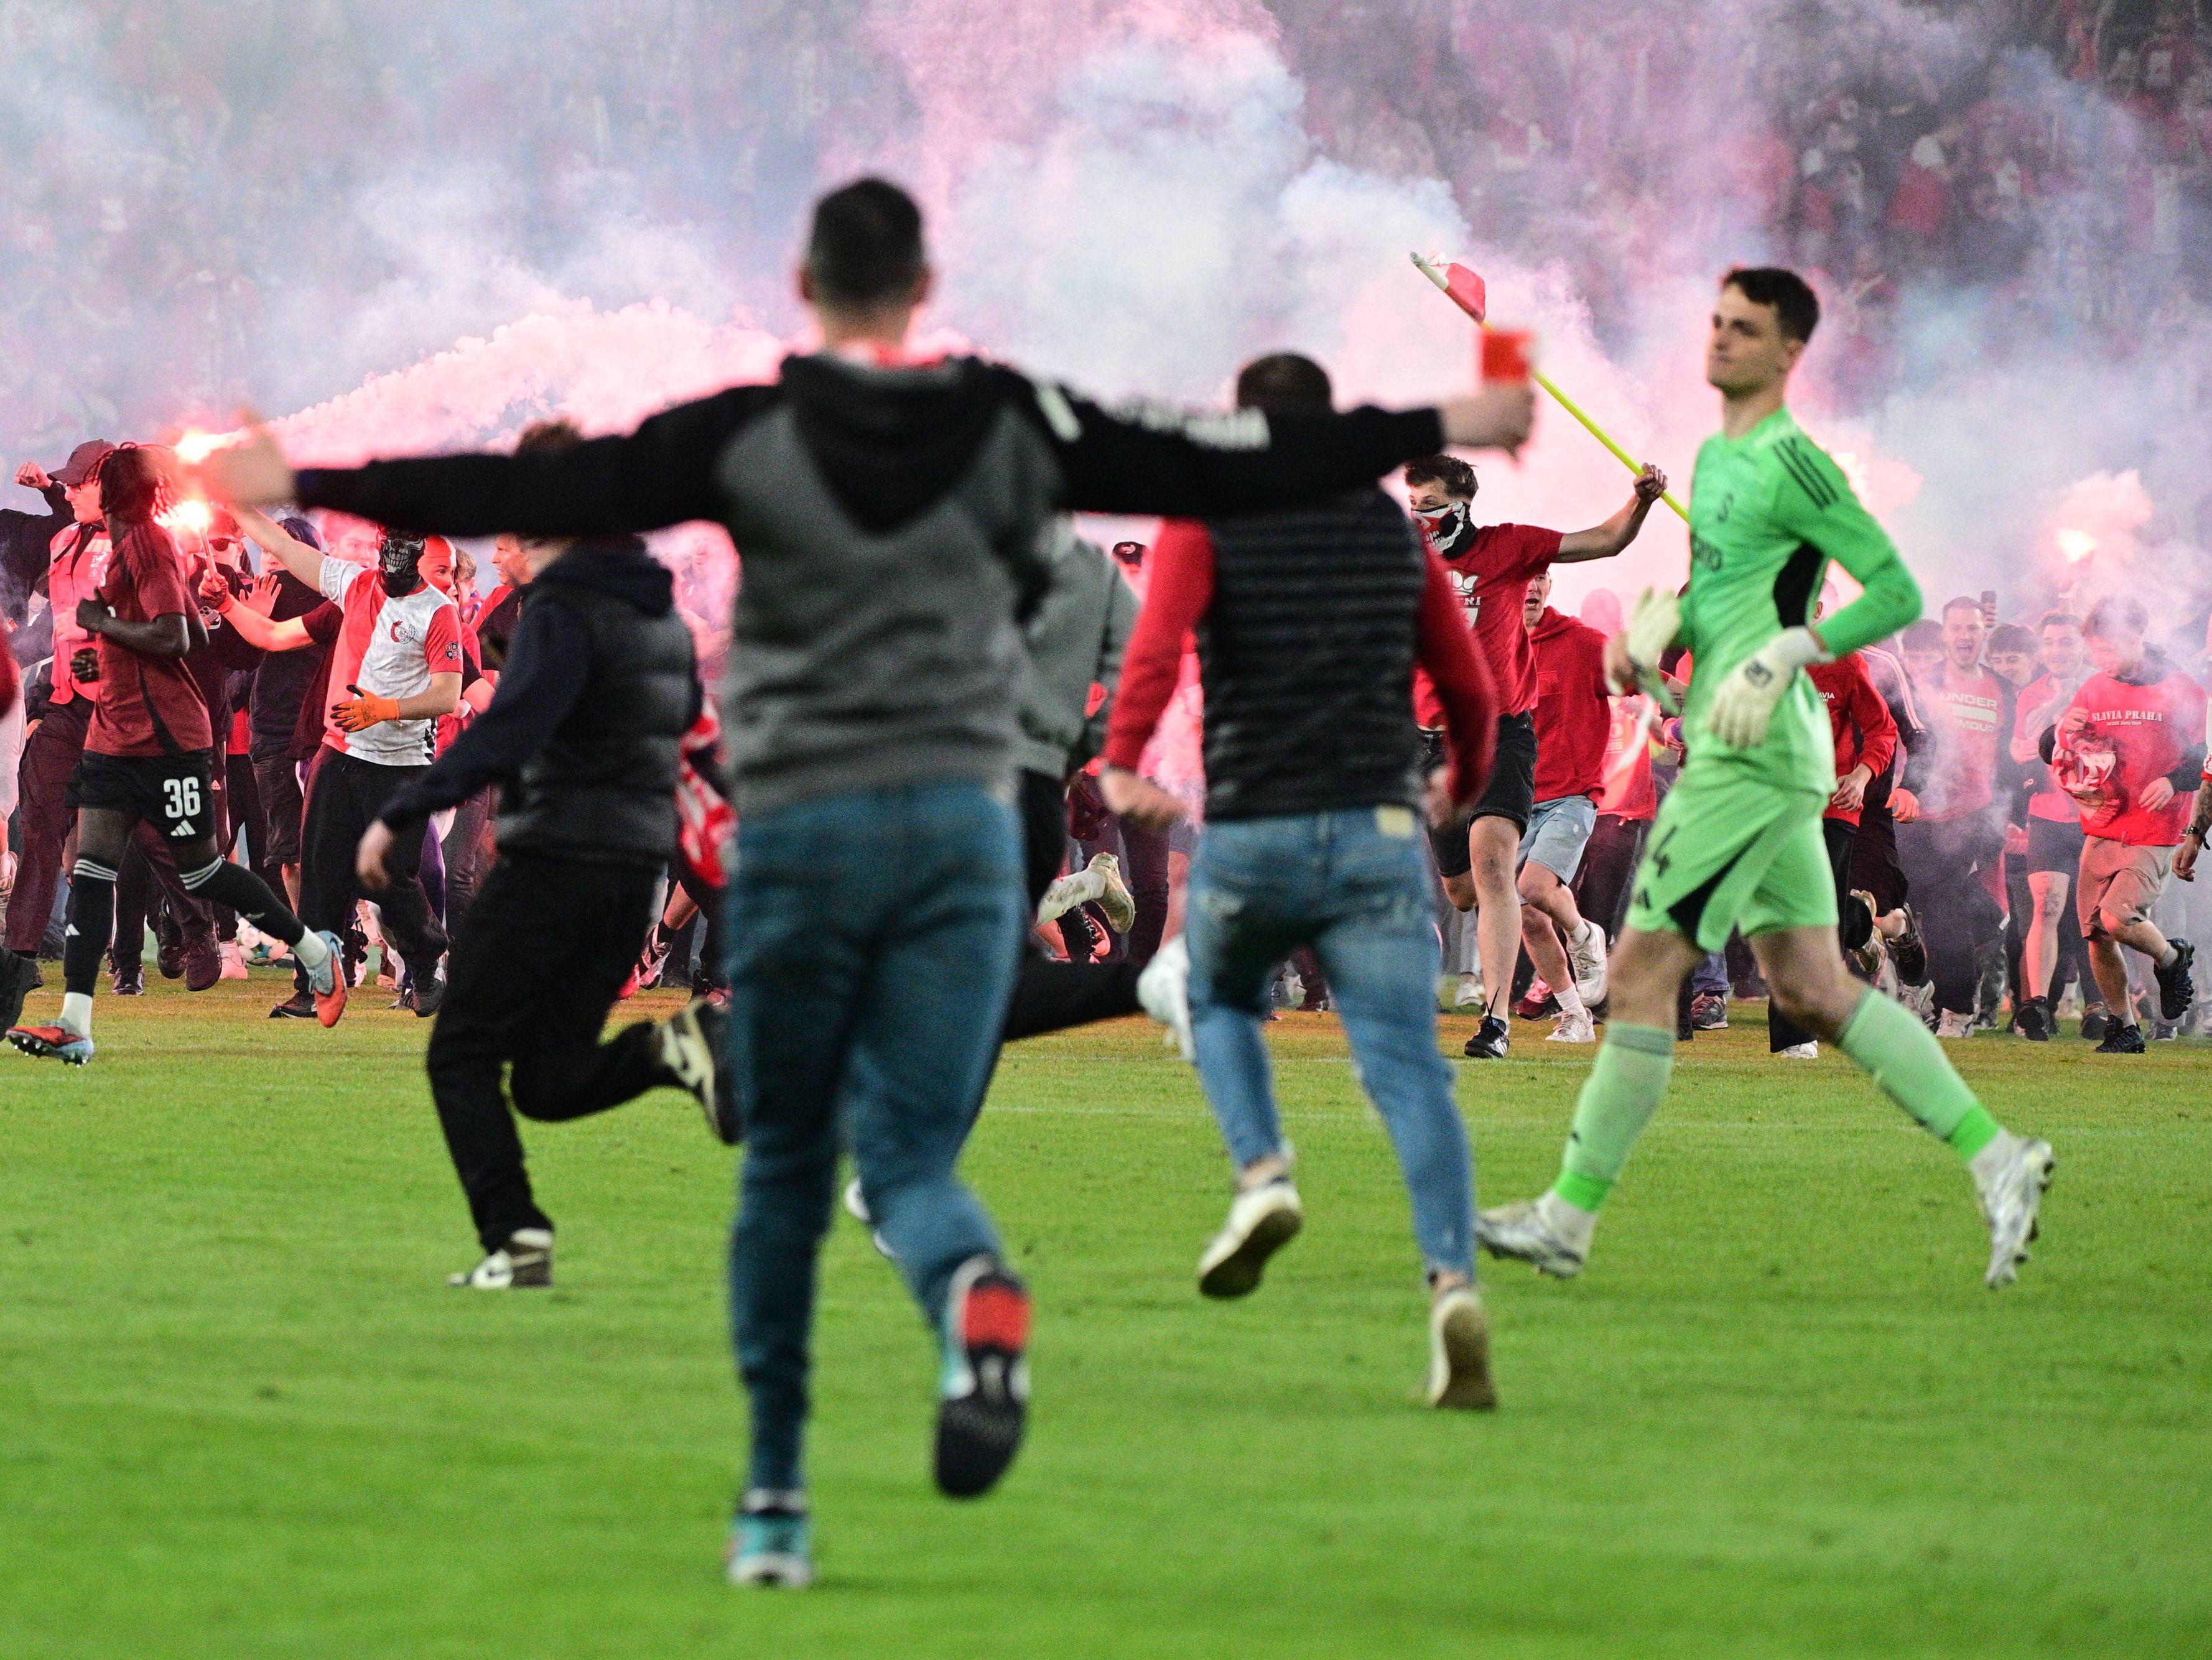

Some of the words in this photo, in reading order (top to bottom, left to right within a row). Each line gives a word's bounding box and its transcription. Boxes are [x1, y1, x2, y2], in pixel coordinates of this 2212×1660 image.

[2091, 710, 2122, 721] SLAVIA
[2125, 710, 2162, 721] PRAHA
[163, 776, 201, 818] 36
